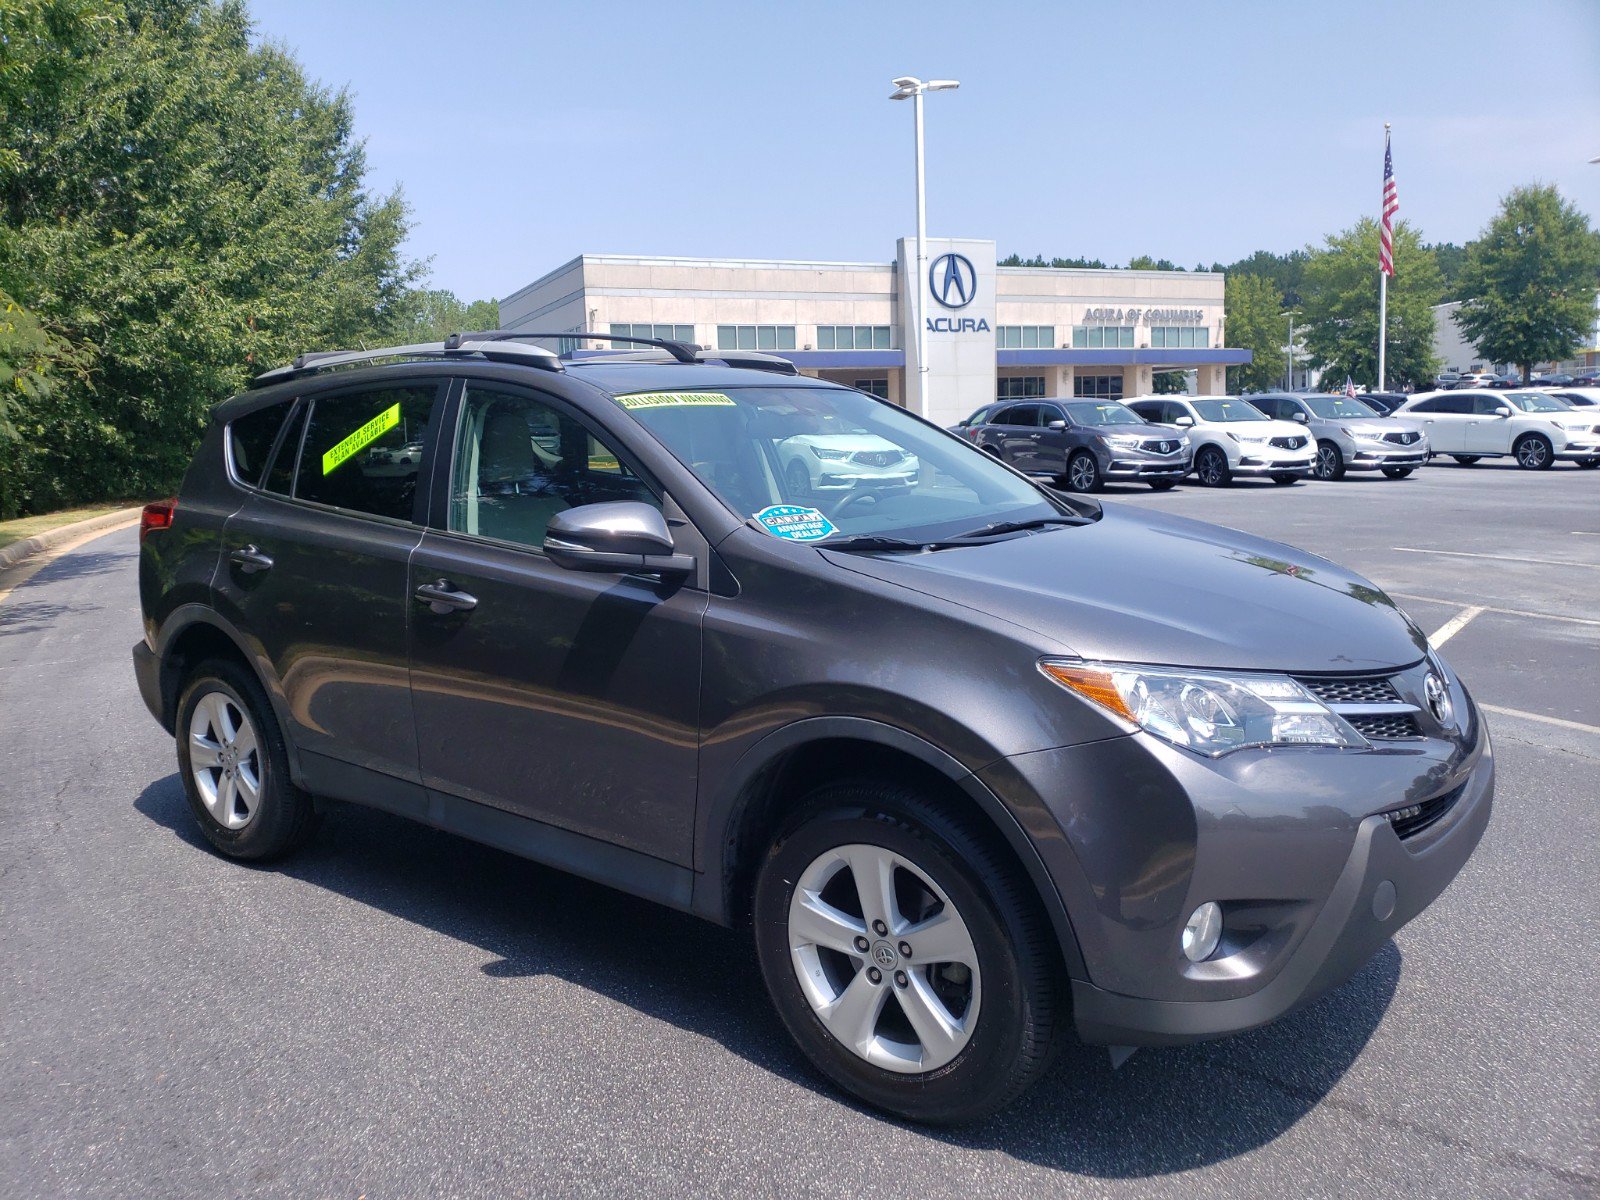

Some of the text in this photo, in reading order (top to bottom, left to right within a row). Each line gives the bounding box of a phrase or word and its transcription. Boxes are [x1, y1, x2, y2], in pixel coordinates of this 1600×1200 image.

[1085, 308, 1204, 321] ACURA OF COLUMBUS
[927, 317, 991, 333] ACURA
[619, 394, 732, 407] COLLISION WARNING
[330, 412, 390, 459] EXTENDED SERVICE
[333, 423, 387, 464] PLAN AVAILABLE
[777, 521, 826, 533] ADVANTAGE
[790, 529, 824, 539] DEALER
